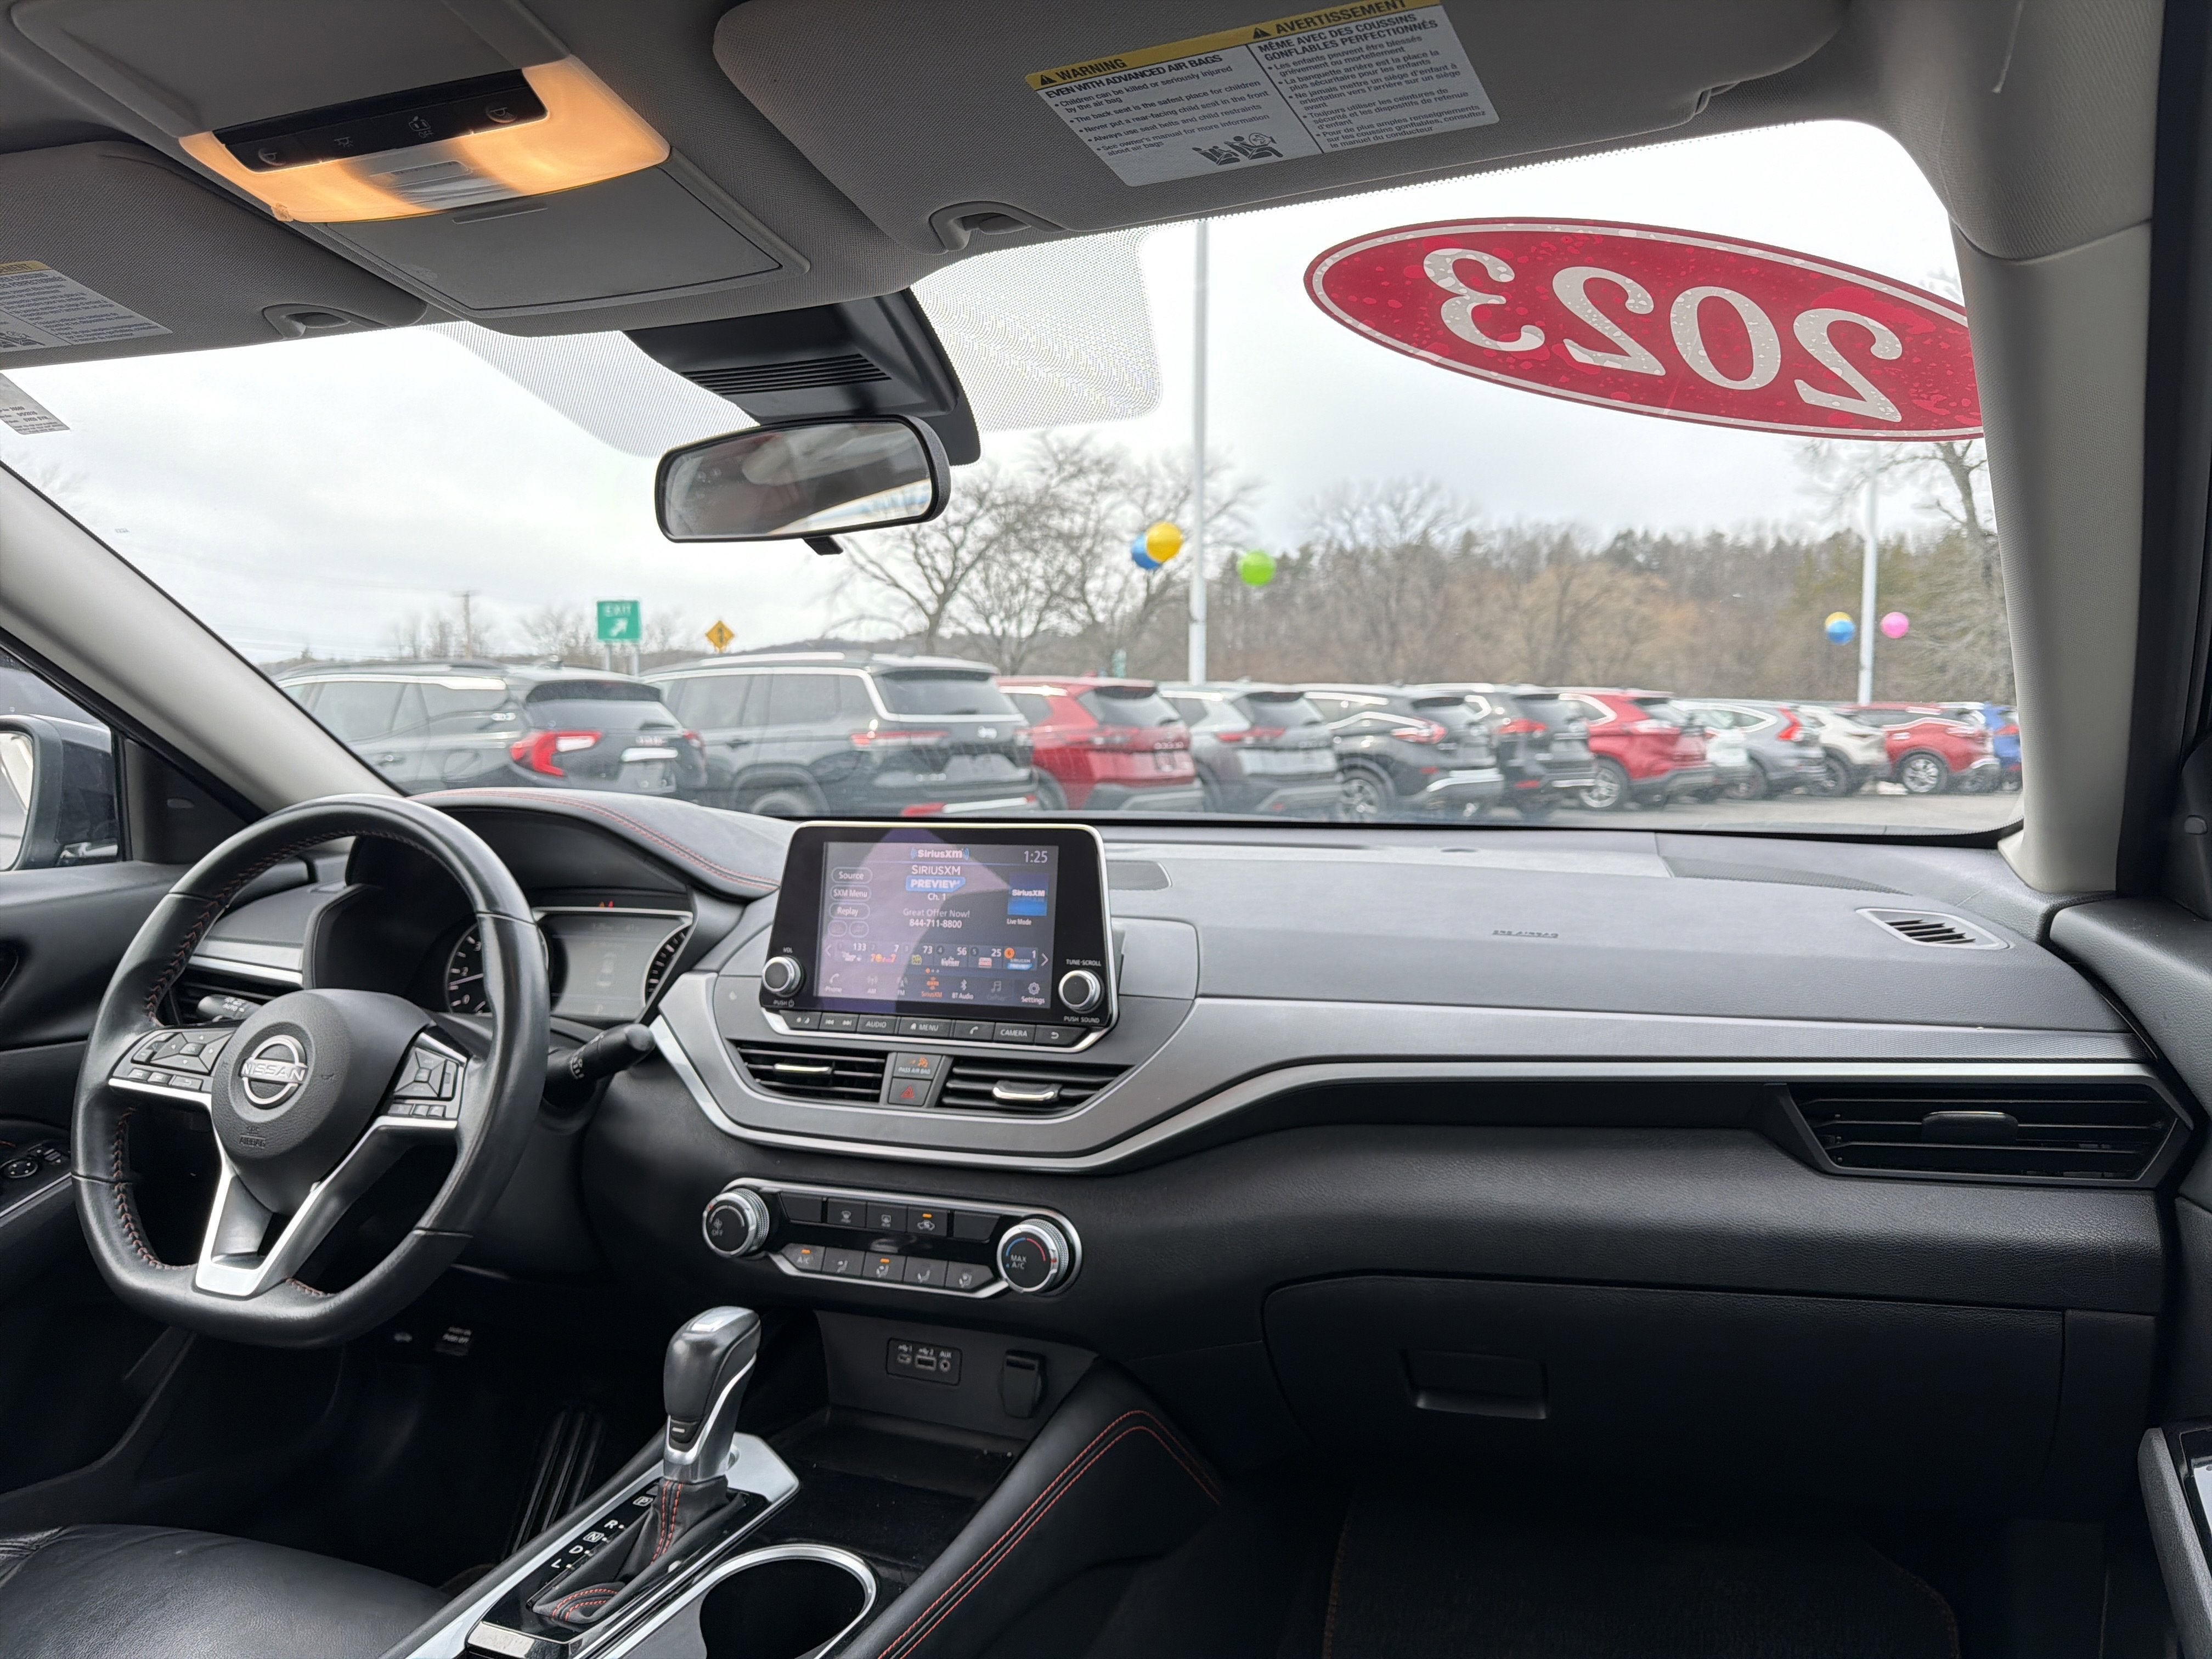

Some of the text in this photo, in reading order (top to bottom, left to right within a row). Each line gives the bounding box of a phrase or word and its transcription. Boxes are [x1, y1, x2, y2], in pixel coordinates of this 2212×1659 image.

[1276, 0, 1406, 34] AVERTISSEMENT
[1257, 14, 1417, 53] MÊME AVEC DES COUSSINS
[1264, 20, 1438, 61] GONFLABLES PERFECTIONNÉS
[1292, 55, 1326, 66] enfants
[1327, 47, 1364, 60] peuvent
[1385, 36, 1423, 47] blessés
[1279, 61, 1330, 77] grièvement
[1344, 46, 1406, 63] mortellement
[1056, 58, 1127, 81] WARNING
[1296, 69, 1342, 82] banquette
[1343, 63, 1374, 72] arrière
[1402, 53, 1428, 62] place
[1045, 54, 1223, 98] EVEN WITH ADVANCED AIR BAGS
[1289, 83, 1309, 92] plus
[1309, 74, 1357, 87] sécuritaire
[1358, 69, 1378, 78] pour
[1396, 59, 1431, 70] enfants
[1059, 95, 1095, 107] Children
[1124, 83, 1149, 93] killed
[1160, 73, 1200, 86] seriously
[1200, 65, 1233, 77] injured
[1308, 86, 1339, 97] jamais
[1339, 81, 1369, 90] mettre
[1384, 73, 1409, 81] siège
[1410, 65, 1449, 76] d'enfant
[1157, 95, 1185, 105] safest
[1184, 92, 1209, 101] place
[1224, 81, 1261, 92] children
[1299, 92, 1346, 105] orientation
[1367, 81, 1403, 92] l'arrière
[1435, 71, 1460, 79] siège
[1084, 123, 1108, 132] Never
[1109, 120, 1125, 128] put
[1131, 110, 1178, 122] rear-facing
[1178, 104, 1200, 113] child
[1200, 100, 1220, 109] seat
[1246, 91, 1269, 99] front
[1093, 132, 1123, 142] Always
[1198, 112, 1220, 120] child
[1220, 105, 1262, 116] restraints
[1119, 137, 1152, 147] owner's
[1152, 130, 1183, 140] manual
[1219, 115, 1269, 127] information
[1107, 147, 1132, 156] about
[1024, 850, 1048, 864] 1:25
[911, 865, 961, 875] SIRIUSXM
[839, 871, 864, 880] Source
[833, 889, 868, 898] SXM Menu
[837, 907, 859, 917] Replay
[903, 908, 970, 918] Great Offer Now!
[909, 918, 962, 928] 844-711-8800
[853, 943, 867, 951] 133
[894, 944, 899, 952] 7
[923, 945, 933, 954] 73
[957, 947, 967, 956] 56
[991, 948, 1002, 957] 25
[1032, 950, 1036, 959] 1
[1021, 996, 1045, 1005] Settings
[865, 1020, 887, 1029] AUDIO
[918, 1023, 939, 1032] MENU
[1000, 1029, 1028, 1037] CAMERA
[241, 1062, 306, 1082] NISSAN
[1011, 1254, 1027, 1263] MAX
[1011, 1261, 1025, 1270] A/C
[604, 1519, 618, 1529] R
[568, 1545, 584, 1554] D
[551, 1558, 562, 1568] L
